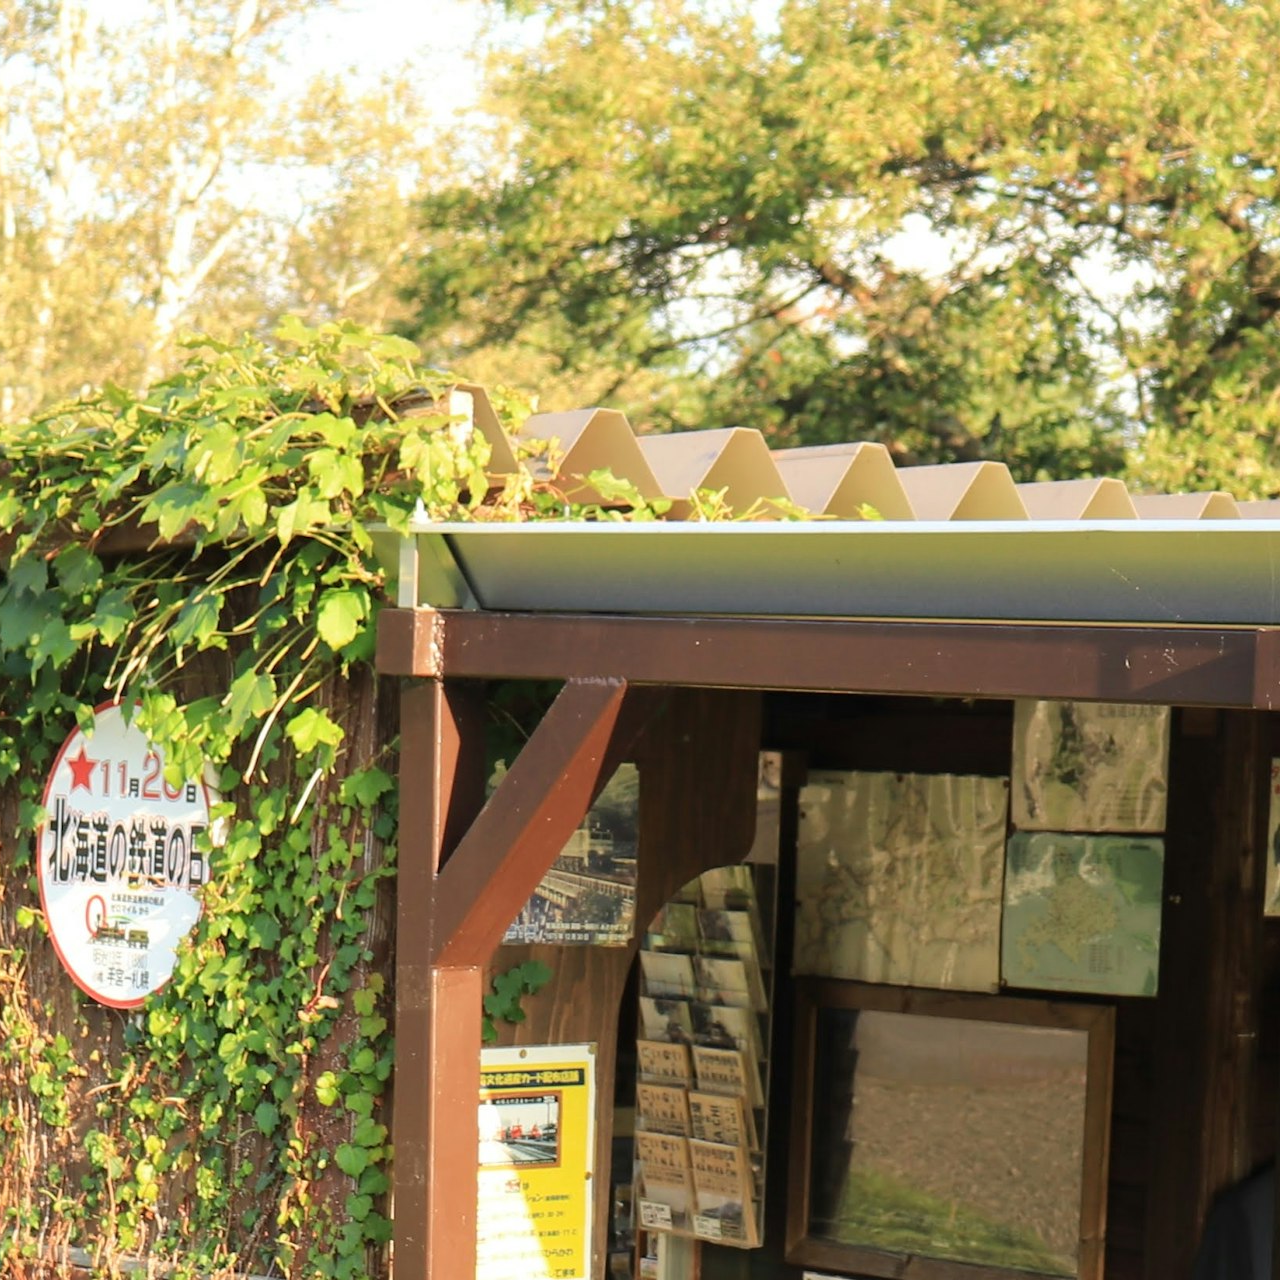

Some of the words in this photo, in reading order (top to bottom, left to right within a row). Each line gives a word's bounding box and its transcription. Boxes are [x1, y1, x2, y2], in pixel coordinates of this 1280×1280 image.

[49, 797, 206, 891] 北海道の鉄道の日
